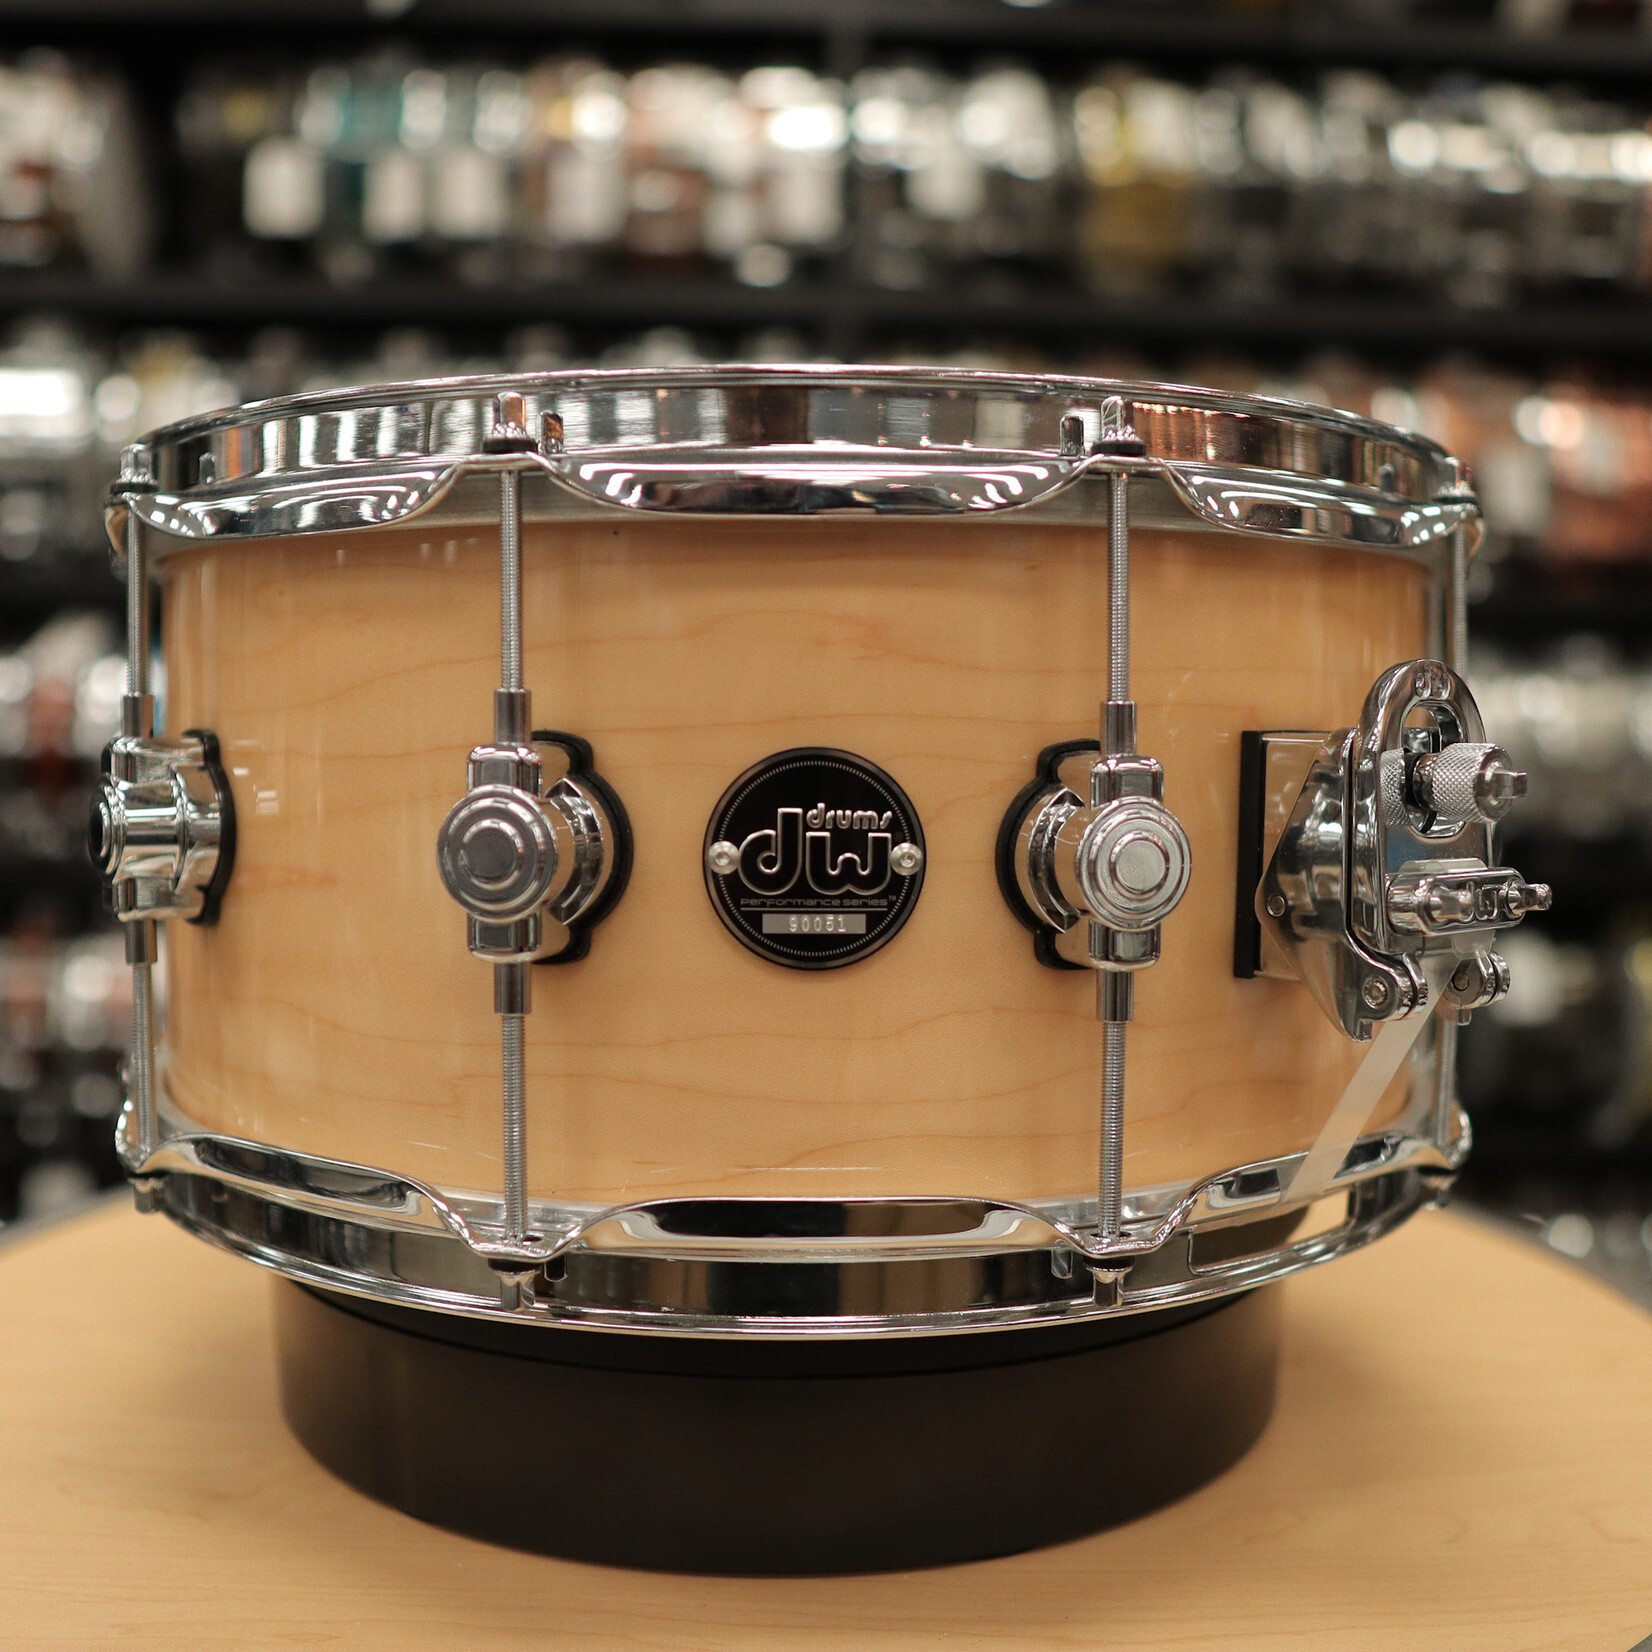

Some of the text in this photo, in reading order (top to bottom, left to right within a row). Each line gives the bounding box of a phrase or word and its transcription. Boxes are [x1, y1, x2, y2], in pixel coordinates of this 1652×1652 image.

[806, 802, 893, 829] drums
[738, 807, 892, 895] dw
[788, 914, 846, 932] 90051
